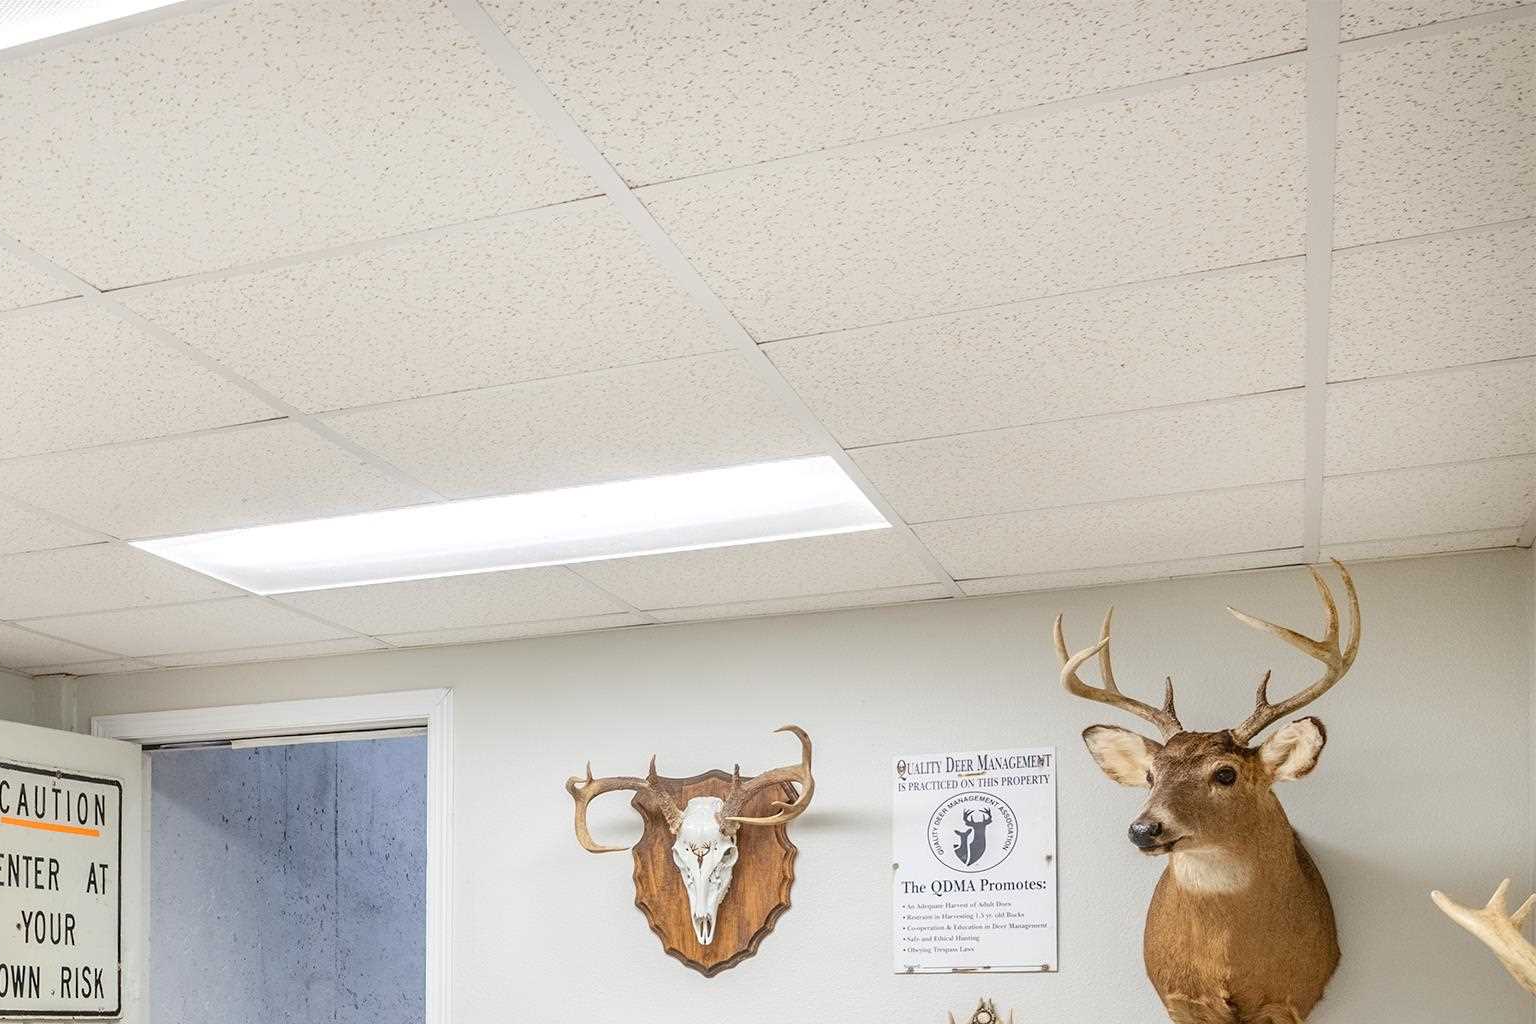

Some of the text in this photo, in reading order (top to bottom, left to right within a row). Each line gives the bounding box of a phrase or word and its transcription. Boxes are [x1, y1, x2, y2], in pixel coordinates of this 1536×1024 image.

[897, 754, 1052, 781] QUALITY DEER MANAGEMENT
[898, 774, 1050, 791] IS PRACTICED ON THIS PROPERTY
[0, 780, 105, 826] CAUTION
[932, 795, 1014, 855] QUALITY DEER MANAGEMENT ASSOCIATION
[86, 862, 108, 895] AT
[901, 878, 1047, 897] The QDMA Promotes:
[22, 910, 75, 945] YOUR
[61, 966, 104, 998] RISK
